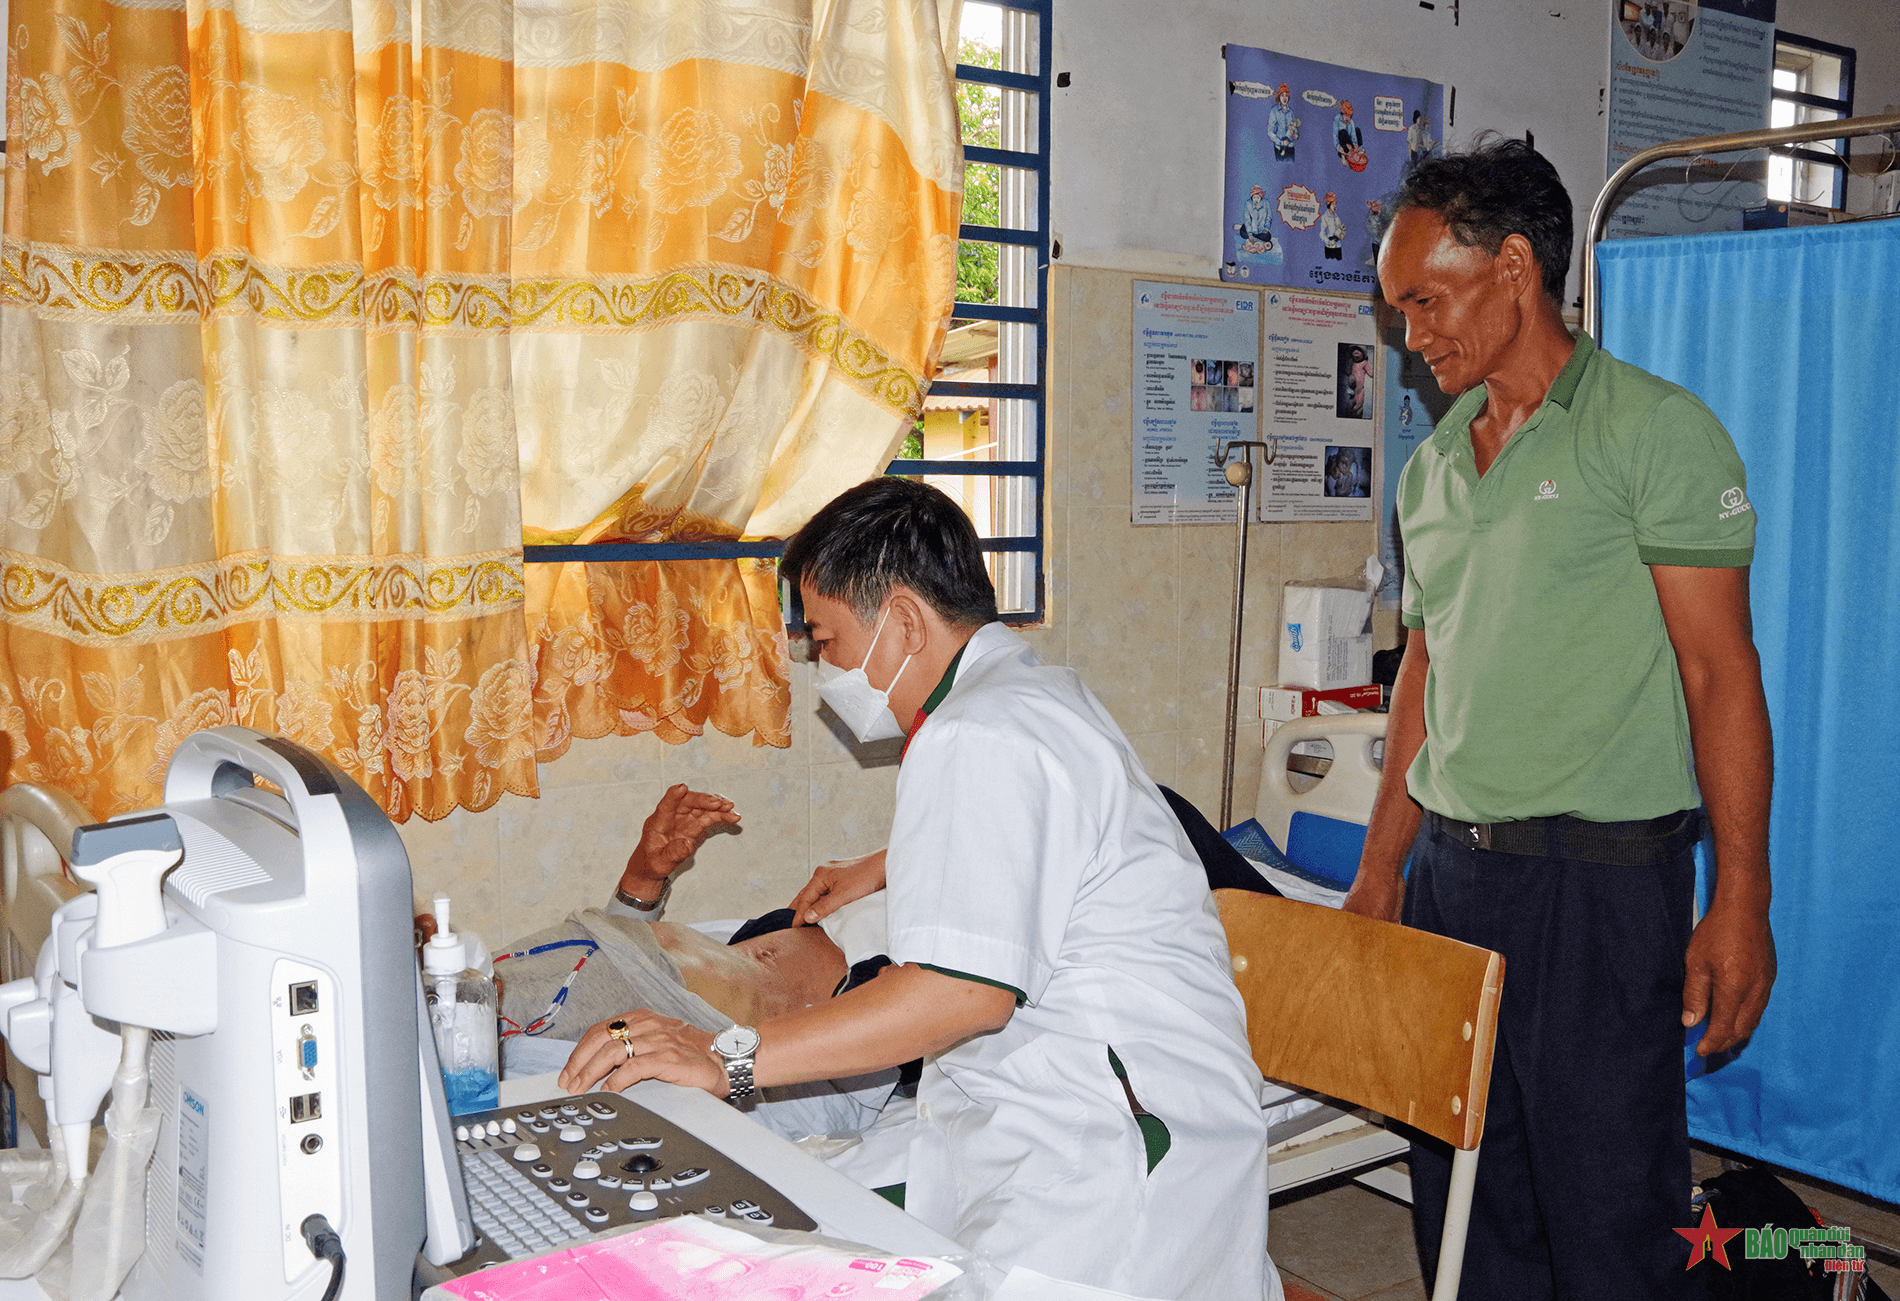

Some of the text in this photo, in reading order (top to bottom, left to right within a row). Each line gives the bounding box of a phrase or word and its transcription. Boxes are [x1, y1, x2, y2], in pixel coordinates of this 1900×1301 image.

[1236, 301, 1254, 311] FIDR
[1358, 305, 1374, 315] FIDR
[285, 1232, 291, 1242] DC
[865, 1261, 883, 1270] 100
